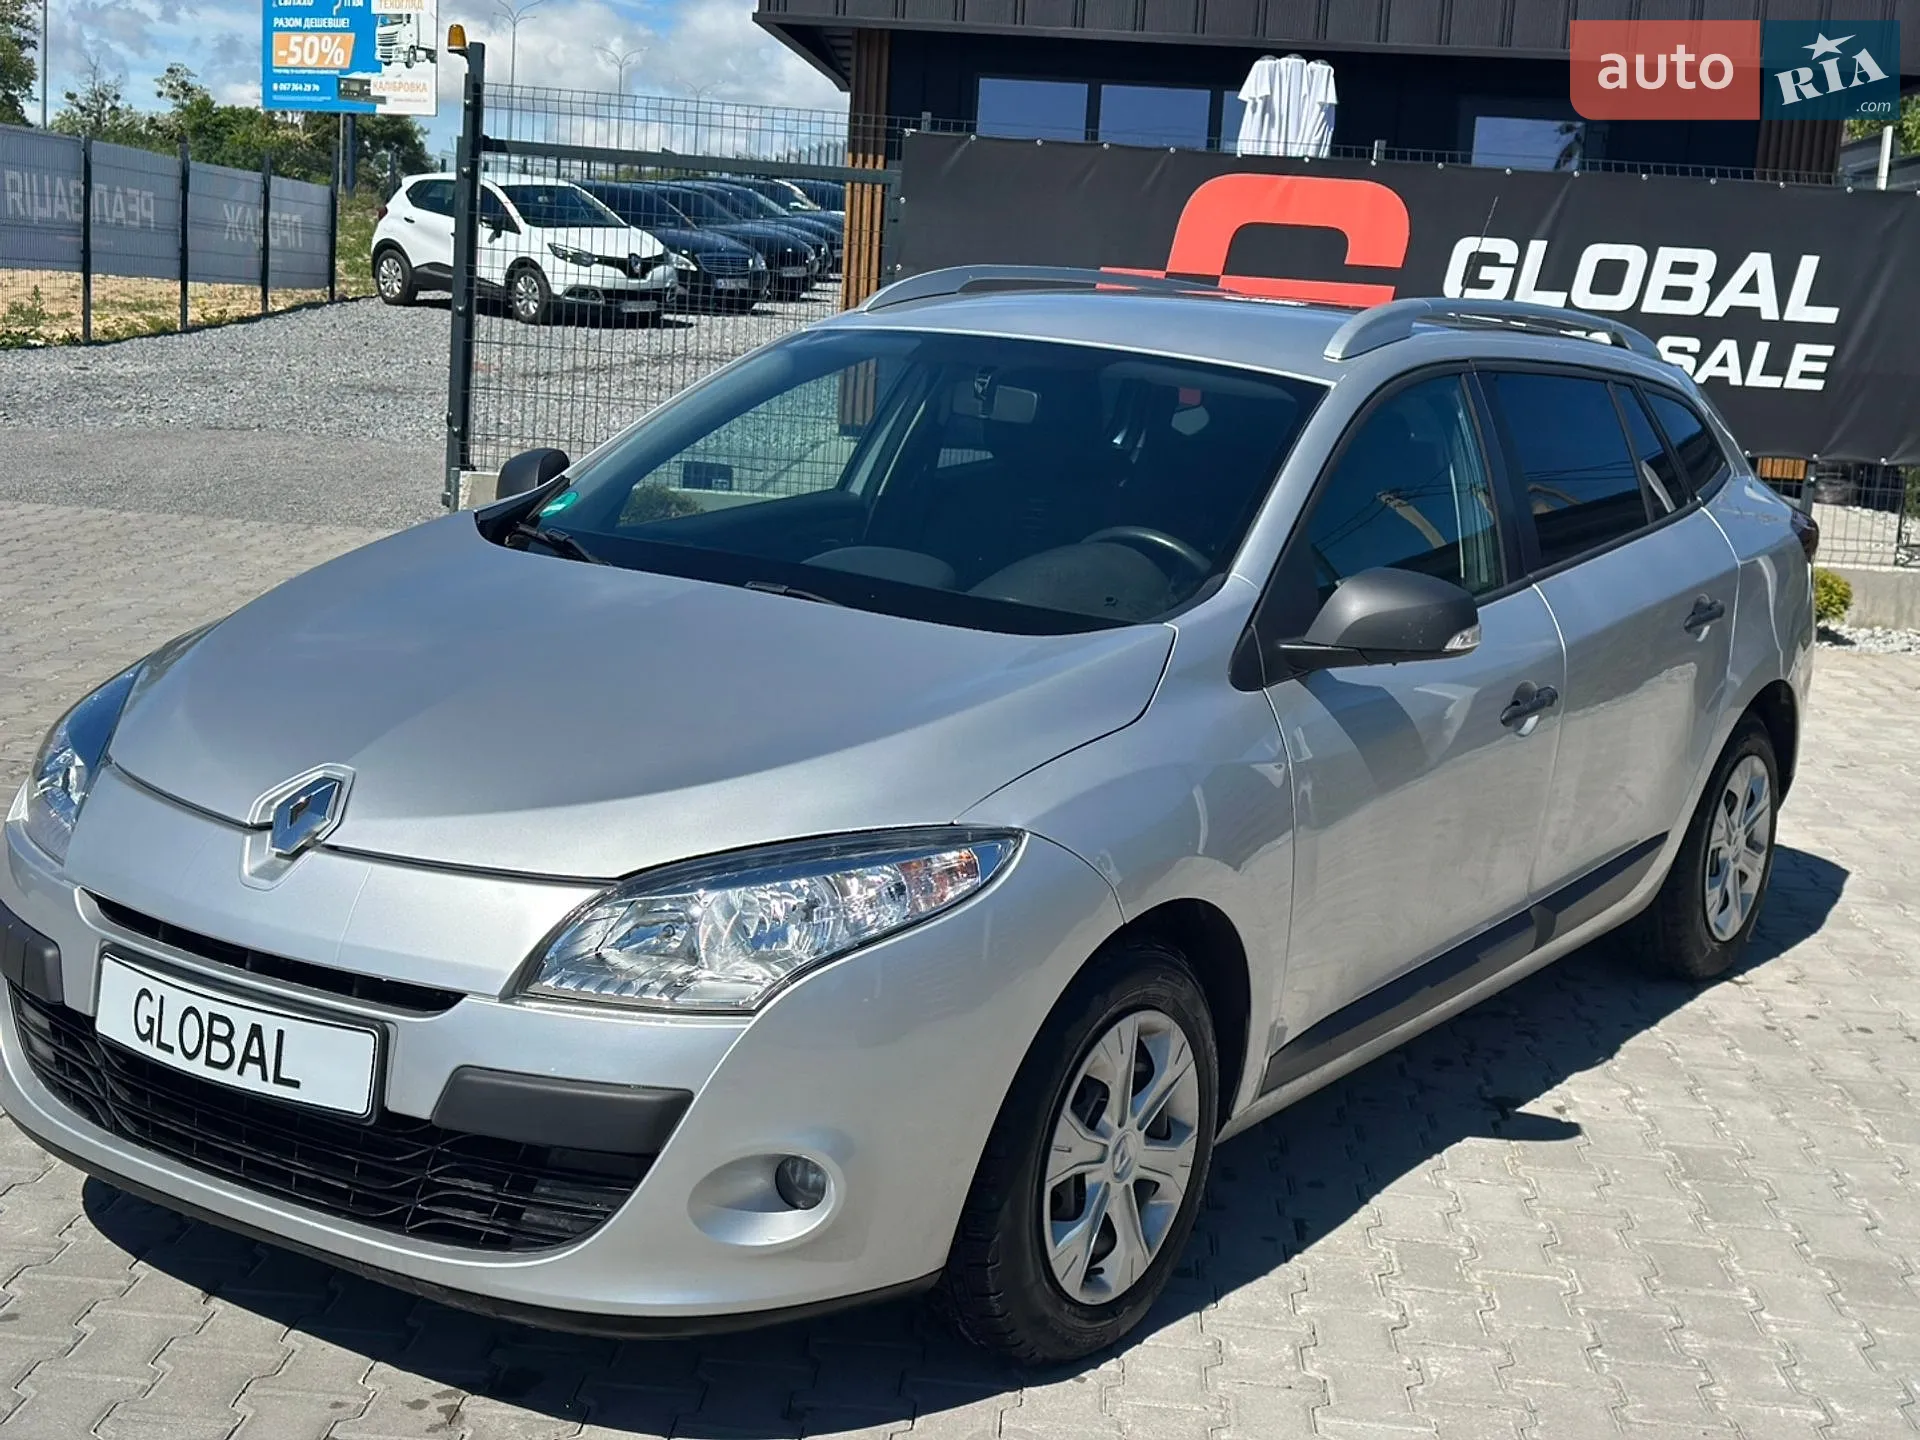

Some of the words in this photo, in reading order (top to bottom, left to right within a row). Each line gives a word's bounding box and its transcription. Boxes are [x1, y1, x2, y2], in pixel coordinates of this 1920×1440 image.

[273, 17, 302, 27] РАЗОМ
[277, 35, 344, 65] -50%
[1442, 236, 1840, 324] GLOBAL
[1655, 336, 1836, 391] SALE
[133, 987, 301, 1089] GLOBAL
